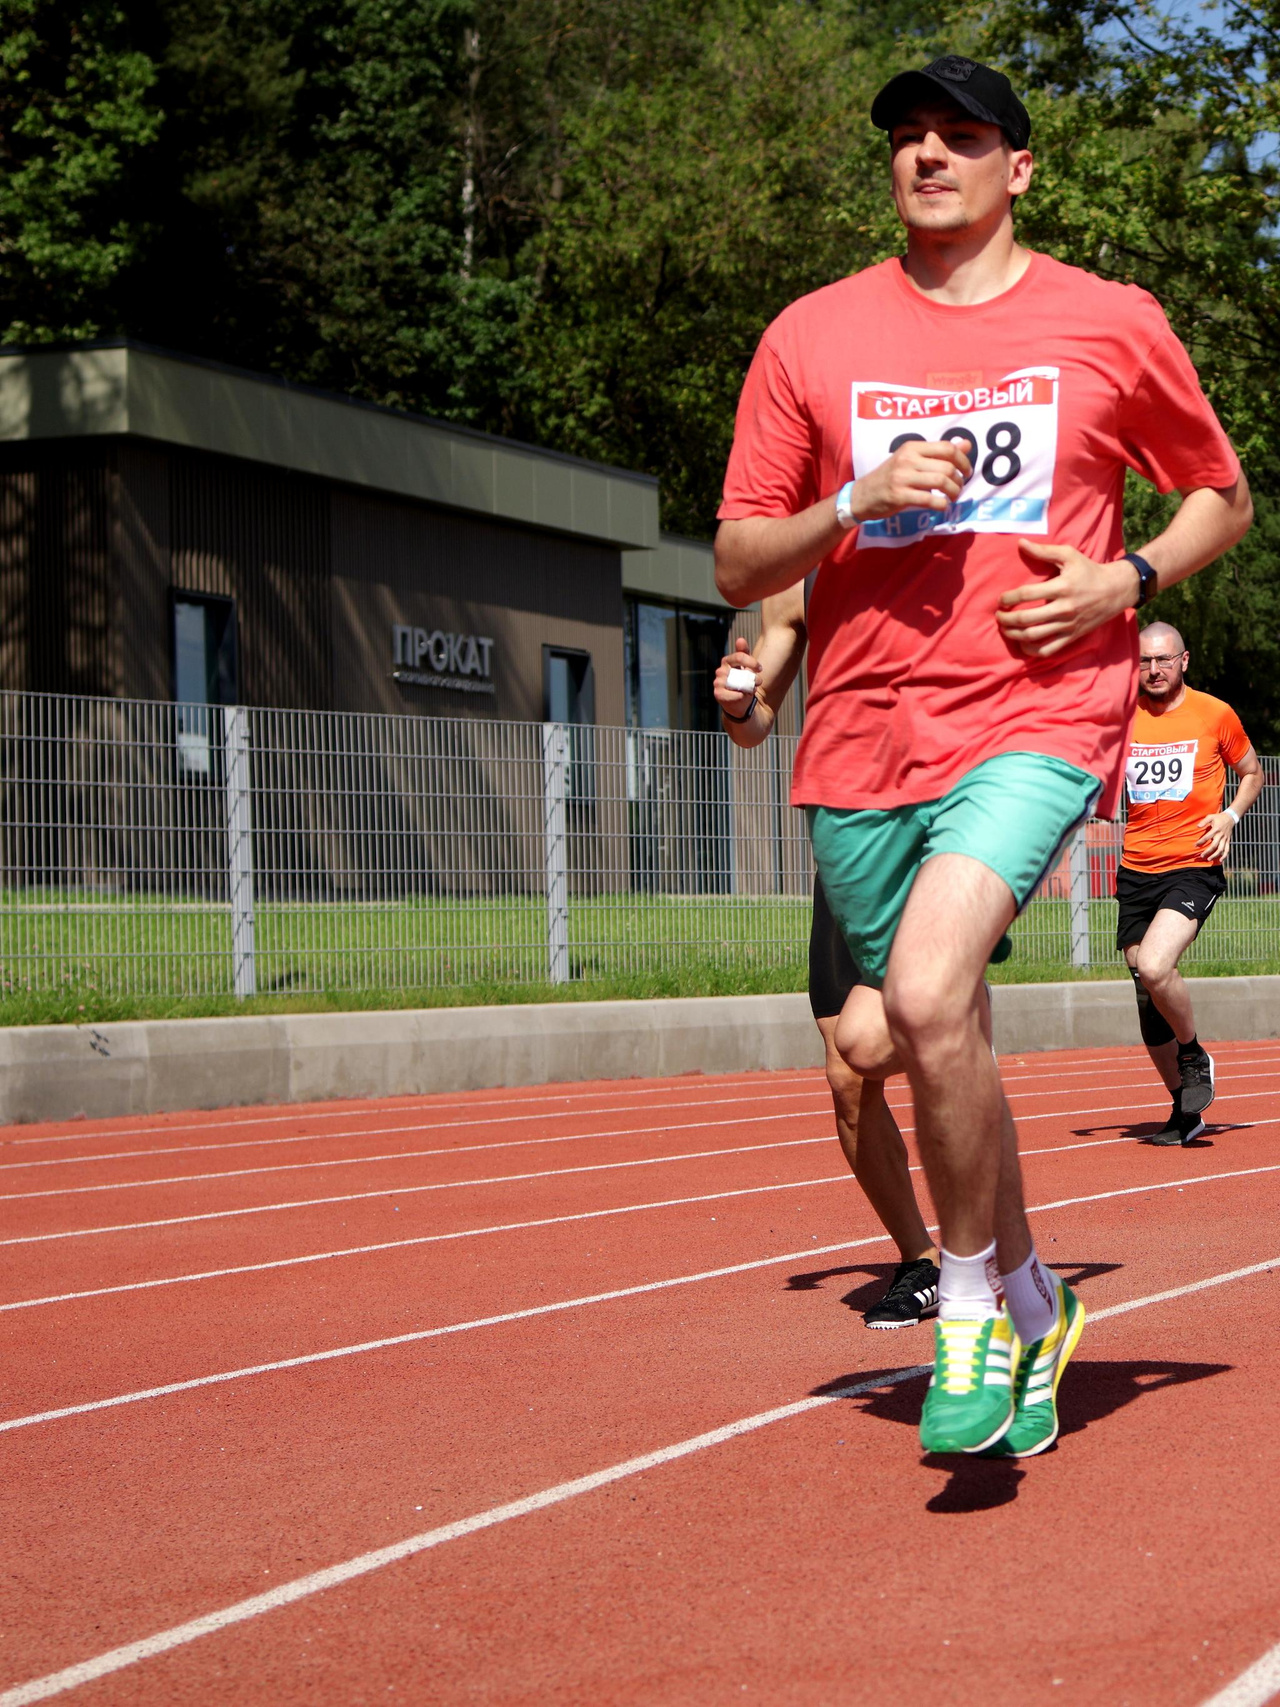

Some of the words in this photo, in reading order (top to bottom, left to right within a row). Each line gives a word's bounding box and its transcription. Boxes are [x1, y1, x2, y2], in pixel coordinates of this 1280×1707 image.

[875, 377, 1034, 418] СТАРТОВЫЙ
[392, 623, 494, 678] ПРОКАТ
[1131, 743, 1189, 757] СТАРТОВЫЙ
[1133, 757, 1183, 785] 299
